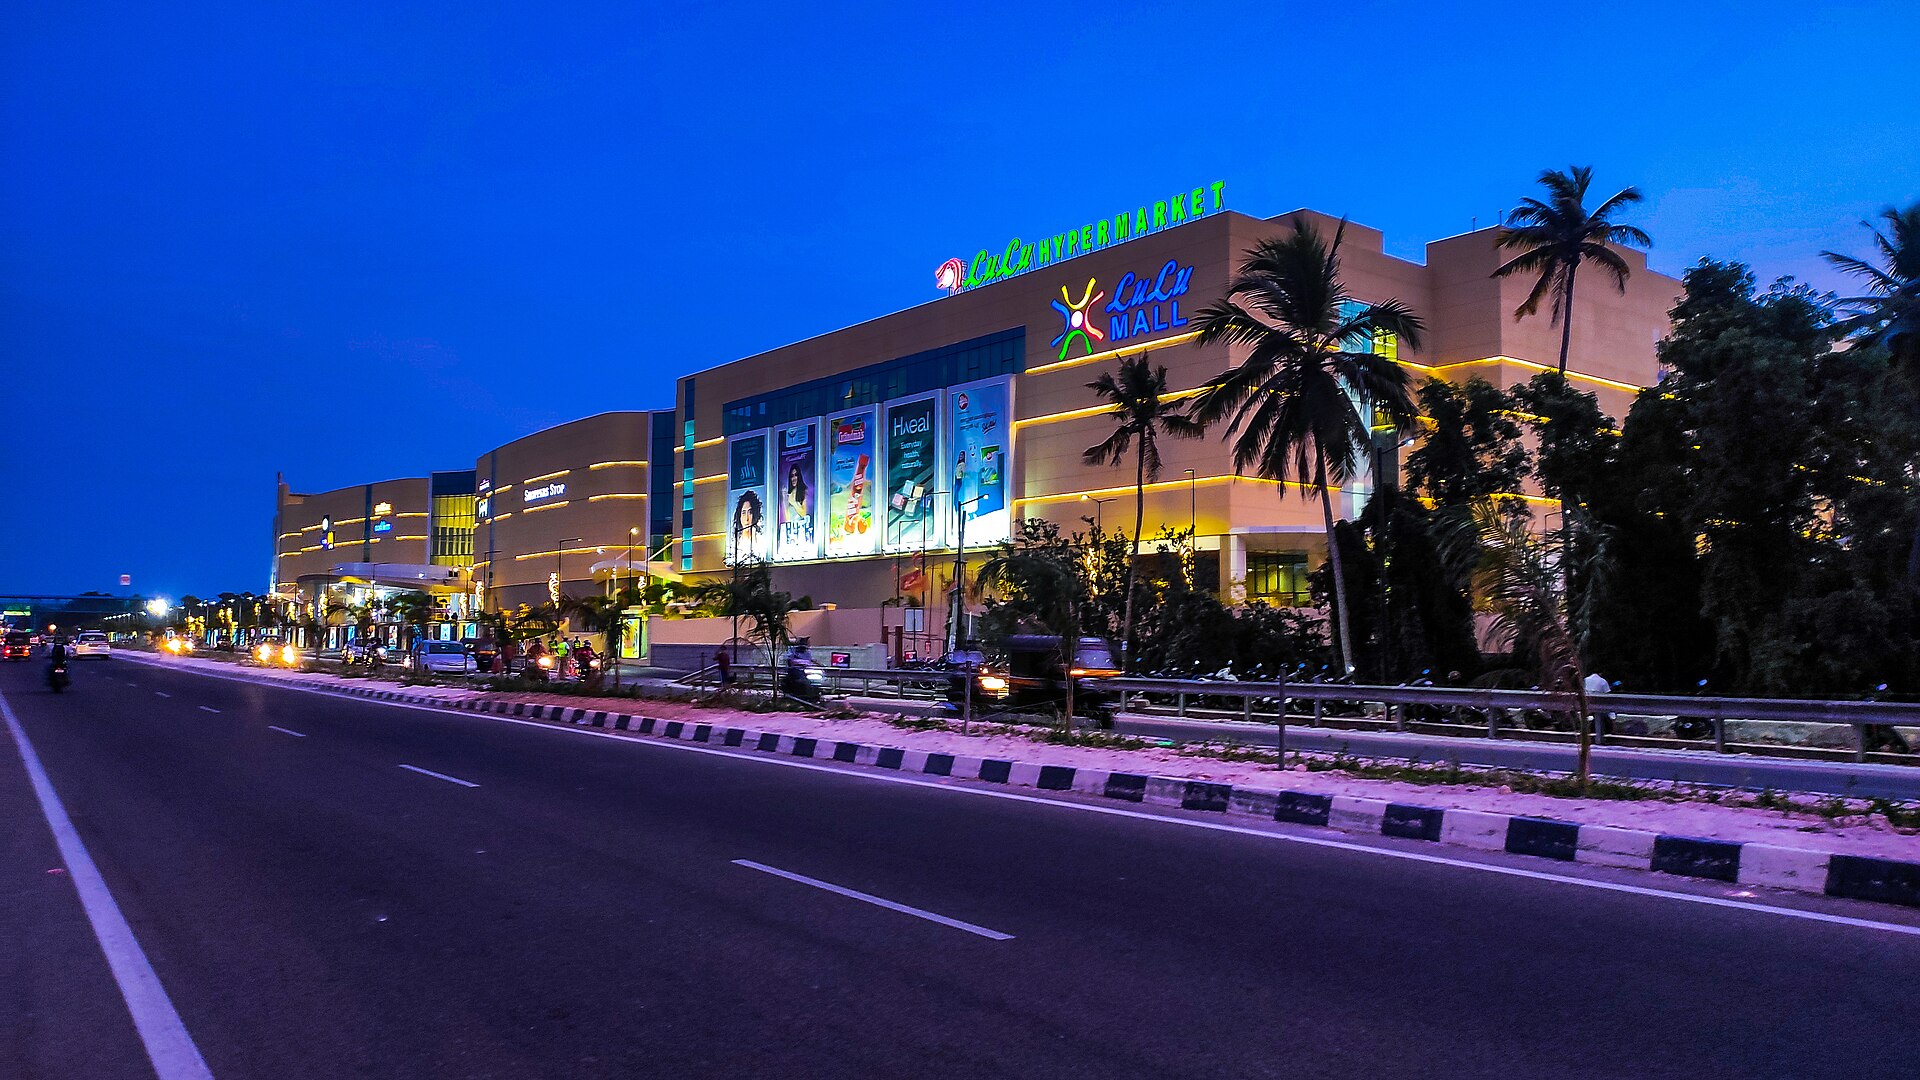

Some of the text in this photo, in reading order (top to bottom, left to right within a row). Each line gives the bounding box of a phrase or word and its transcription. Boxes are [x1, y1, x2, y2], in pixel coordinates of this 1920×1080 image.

[962, 180, 1225, 288] LuLu HYPERMARKET
[1105, 259, 1194, 313] LuLu
[1110, 301, 1188, 341] MALL
